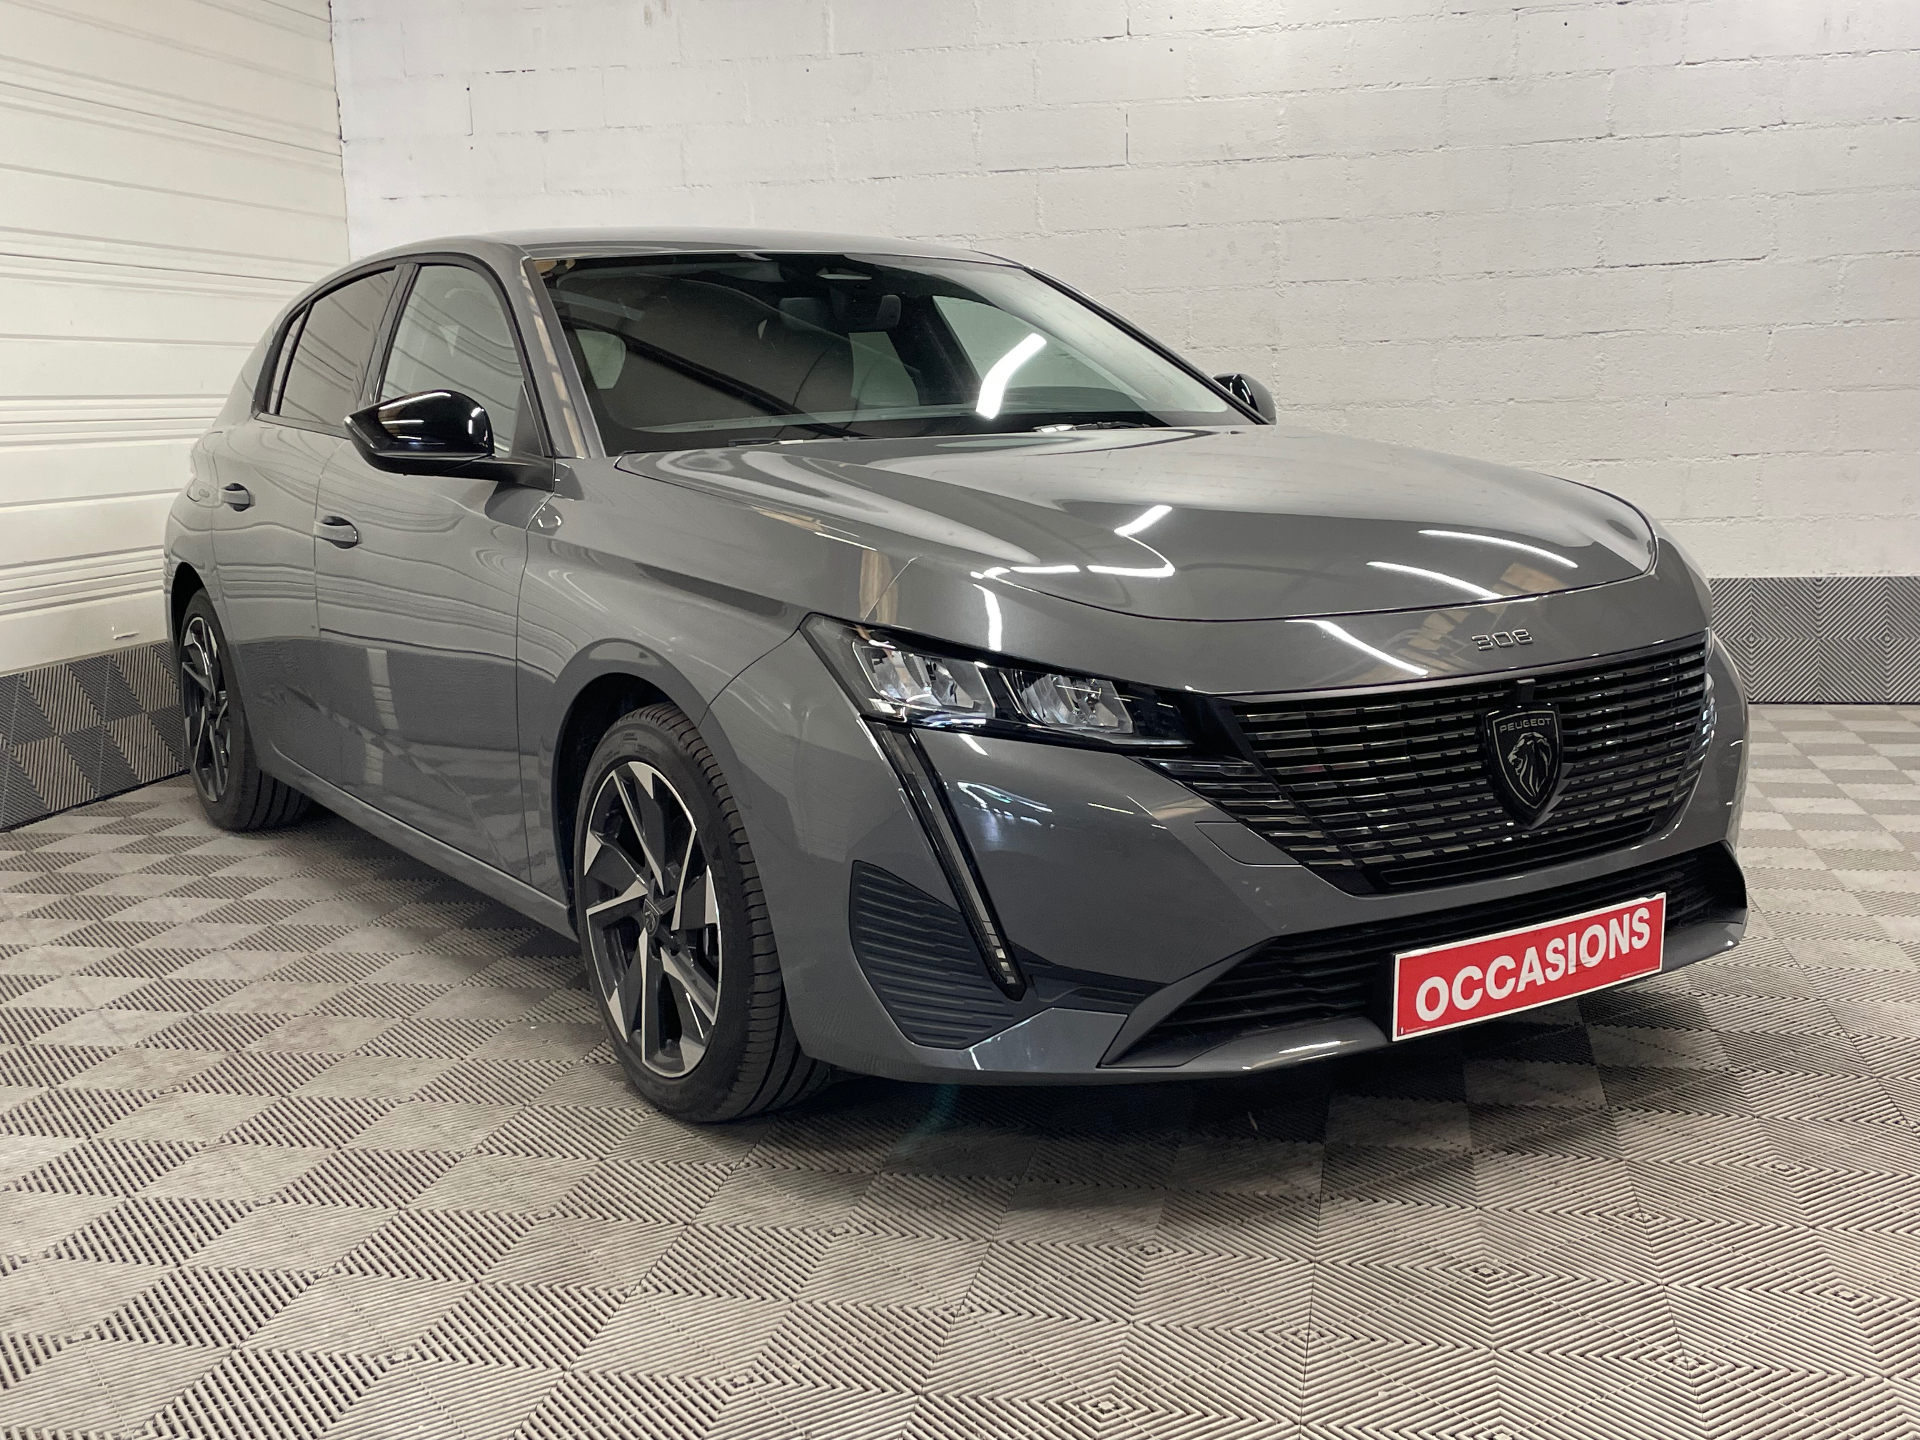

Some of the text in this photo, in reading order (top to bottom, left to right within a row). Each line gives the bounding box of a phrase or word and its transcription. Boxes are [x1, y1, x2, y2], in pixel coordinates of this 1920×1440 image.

[1471, 628, 1533, 651] 308
[1499, 717, 1552, 734] PEUGEOT
[1415, 907, 1650, 1022] OCCASIONS
